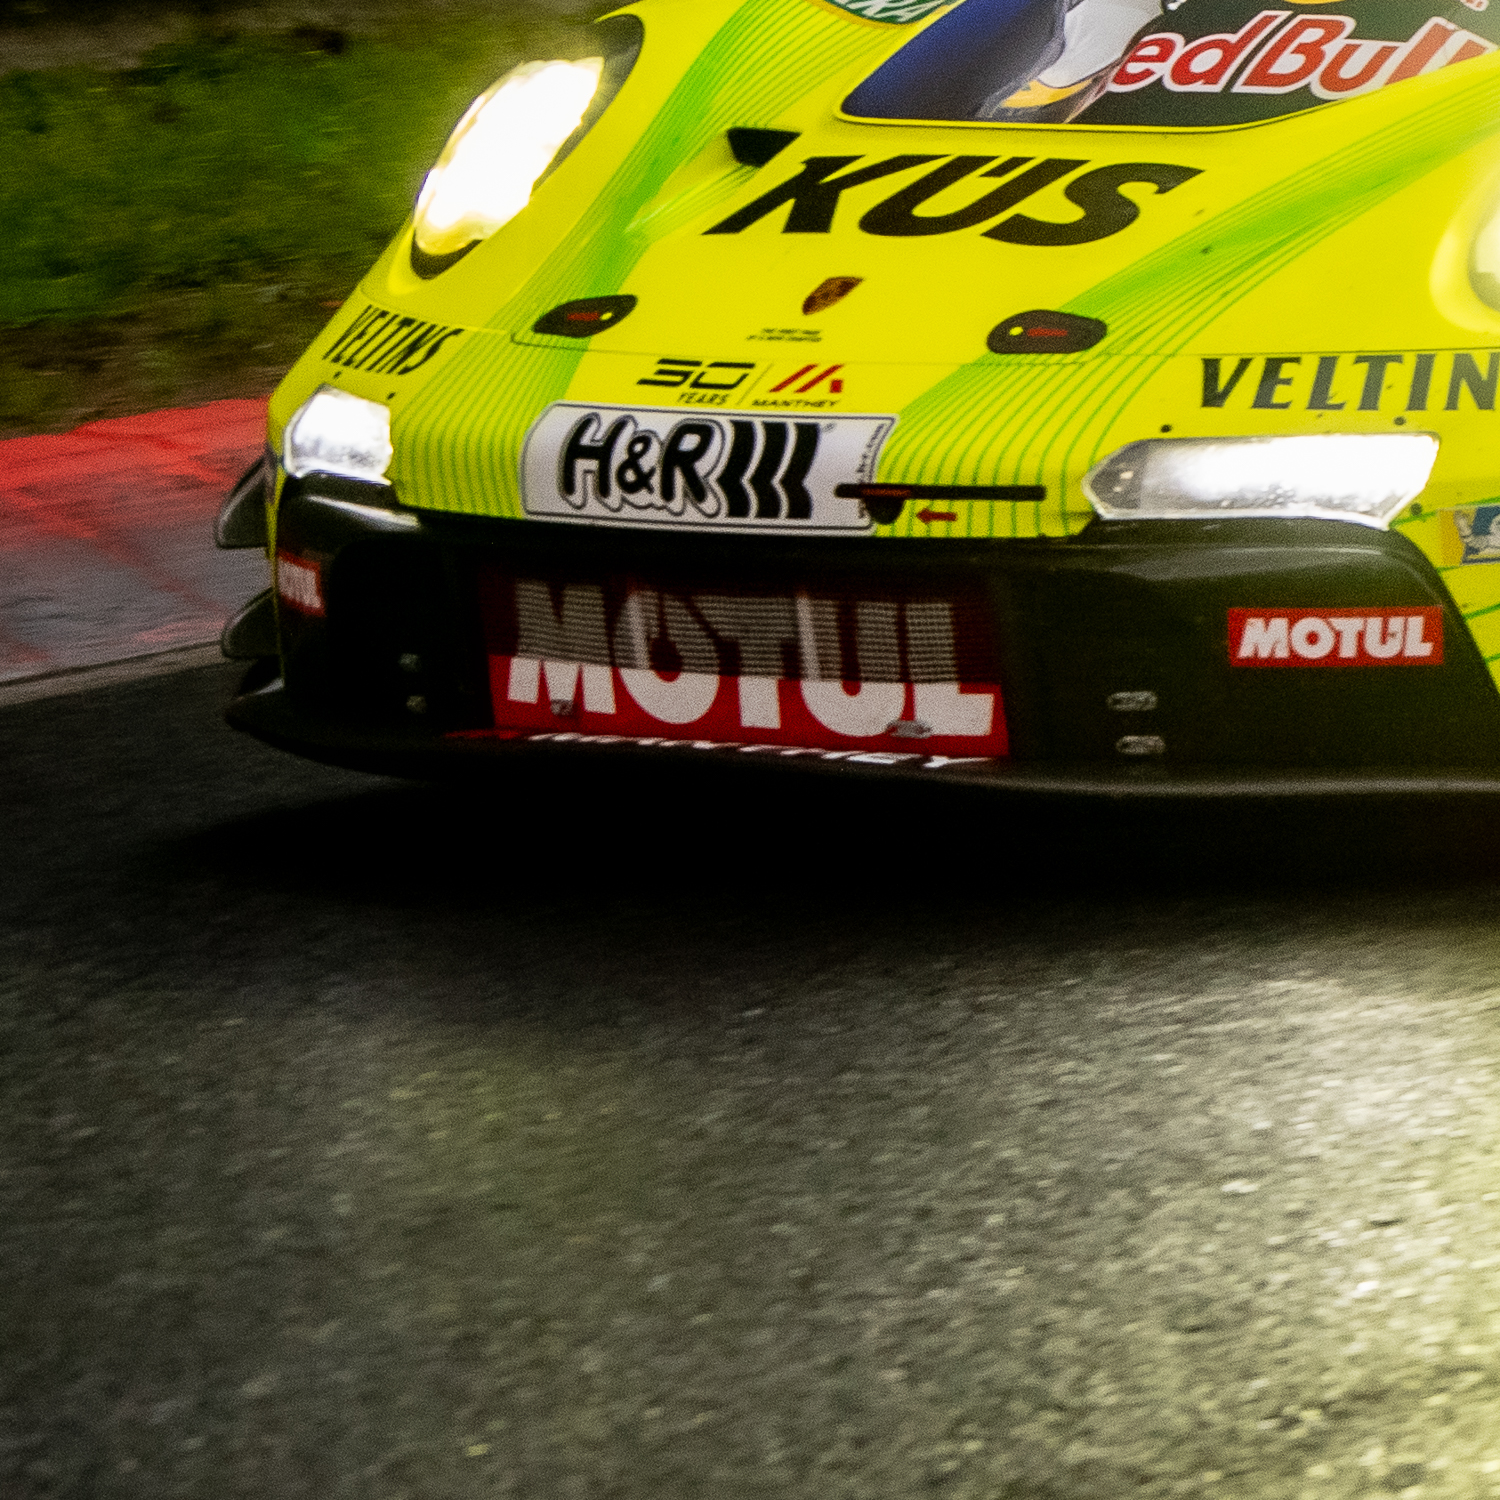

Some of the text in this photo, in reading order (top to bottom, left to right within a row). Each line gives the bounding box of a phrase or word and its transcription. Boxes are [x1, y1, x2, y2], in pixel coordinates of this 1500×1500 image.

[1107, 10, 1293, 93] ed
[702, 154, 1206, 247] KÜS
[322, 303, 466, 376] VELTINS
[558, 412, 728, 518] H&R
[507, 577, 995, 738] MOTUL
[1237, 616, 1435, 662] MOTUL
